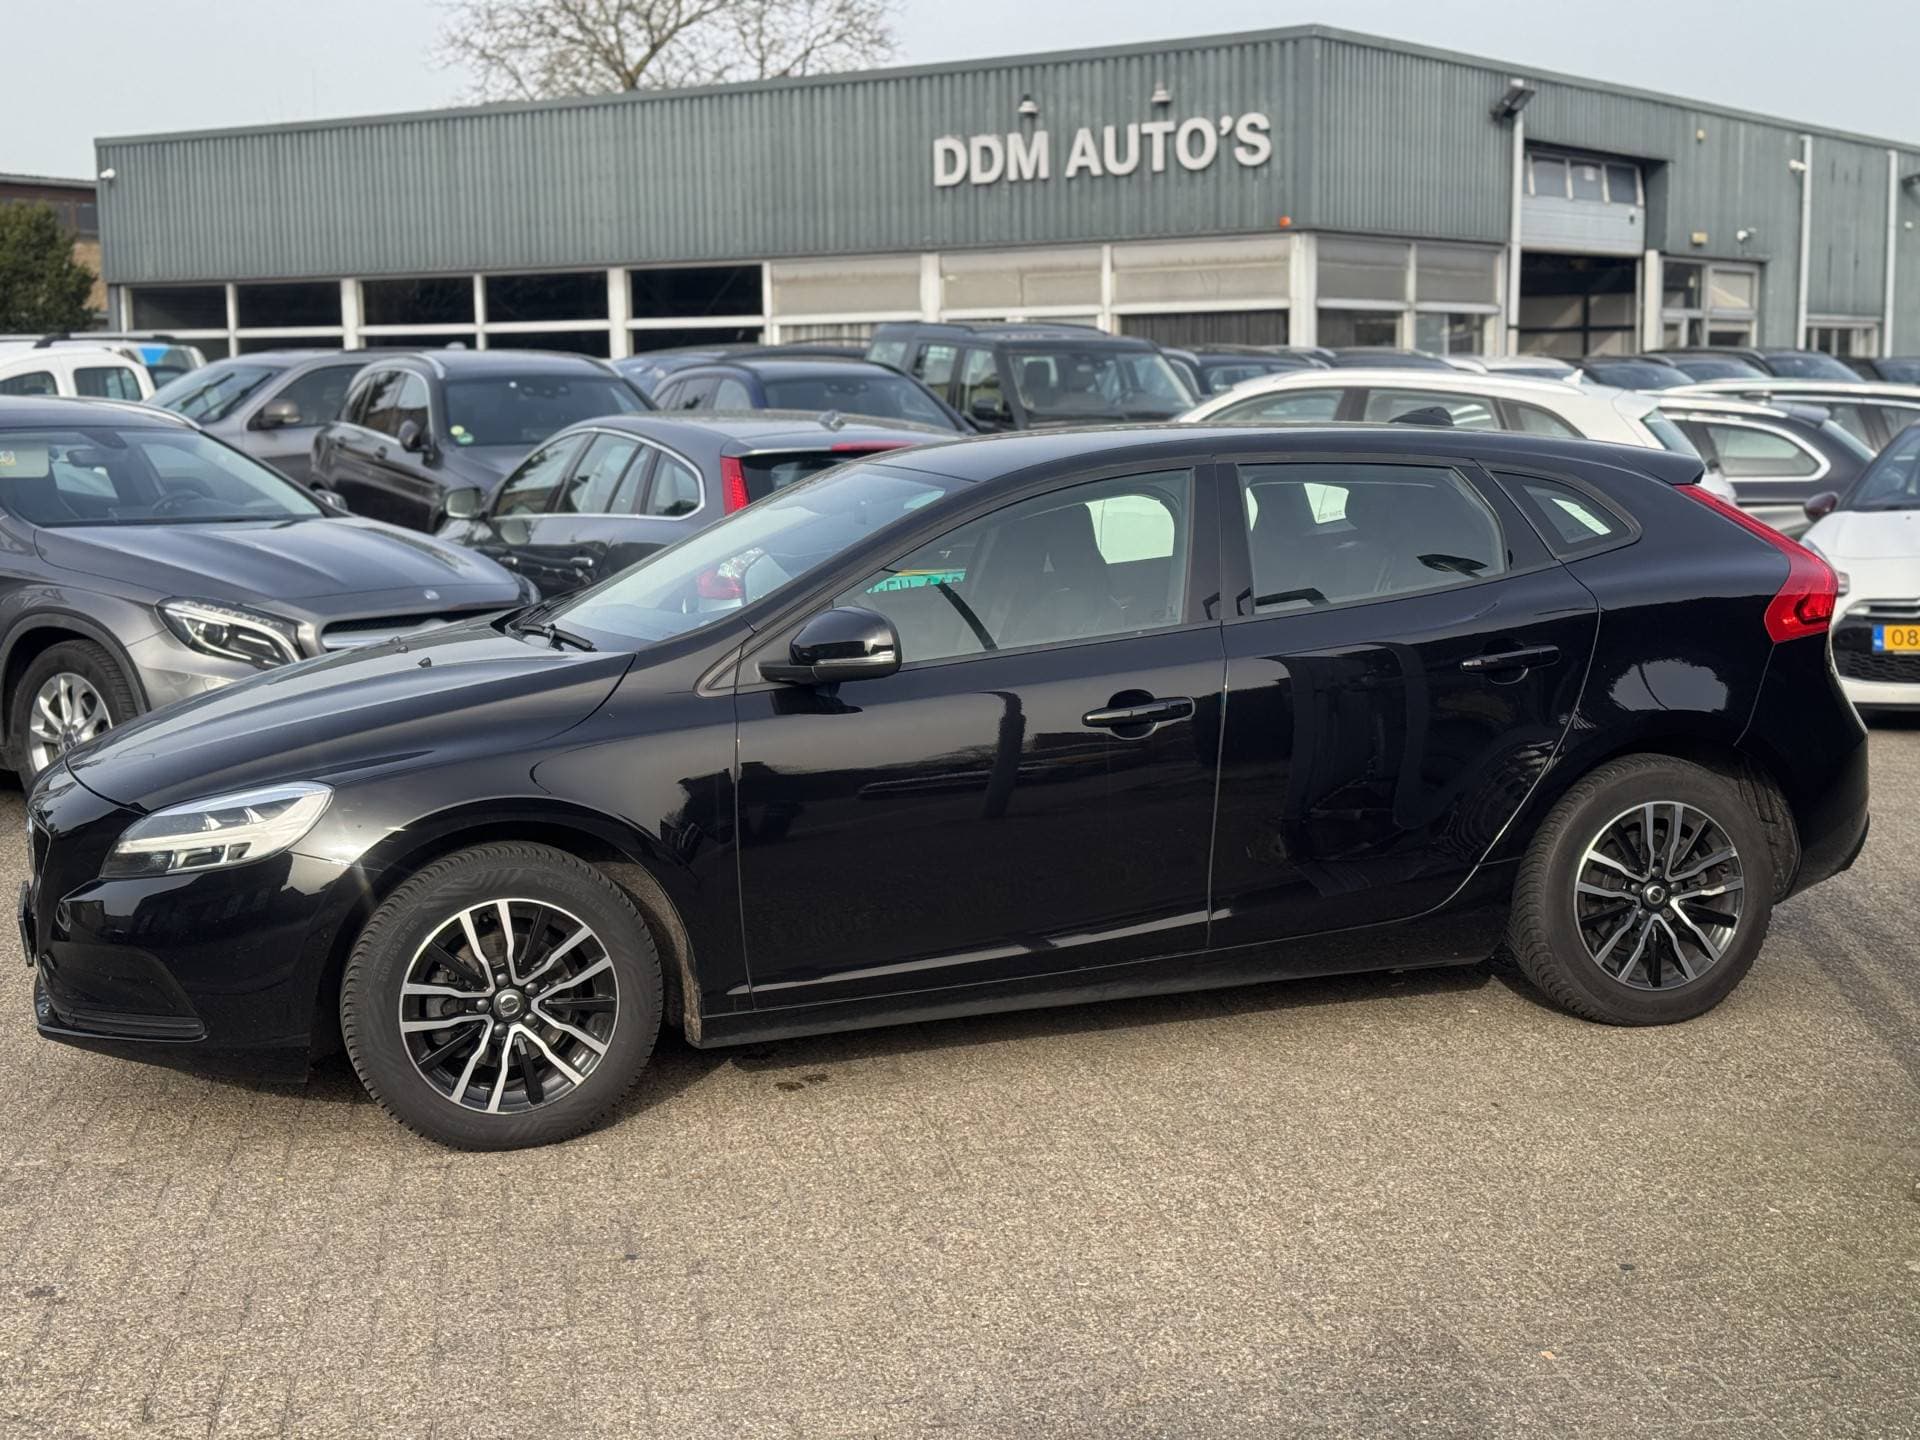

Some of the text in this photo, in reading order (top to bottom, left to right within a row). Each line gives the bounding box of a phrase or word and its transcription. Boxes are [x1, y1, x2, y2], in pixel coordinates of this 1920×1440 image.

[933, 112, 1272, 186] DDM AUTO'S
[1891, 628, 1919, 647] 08
